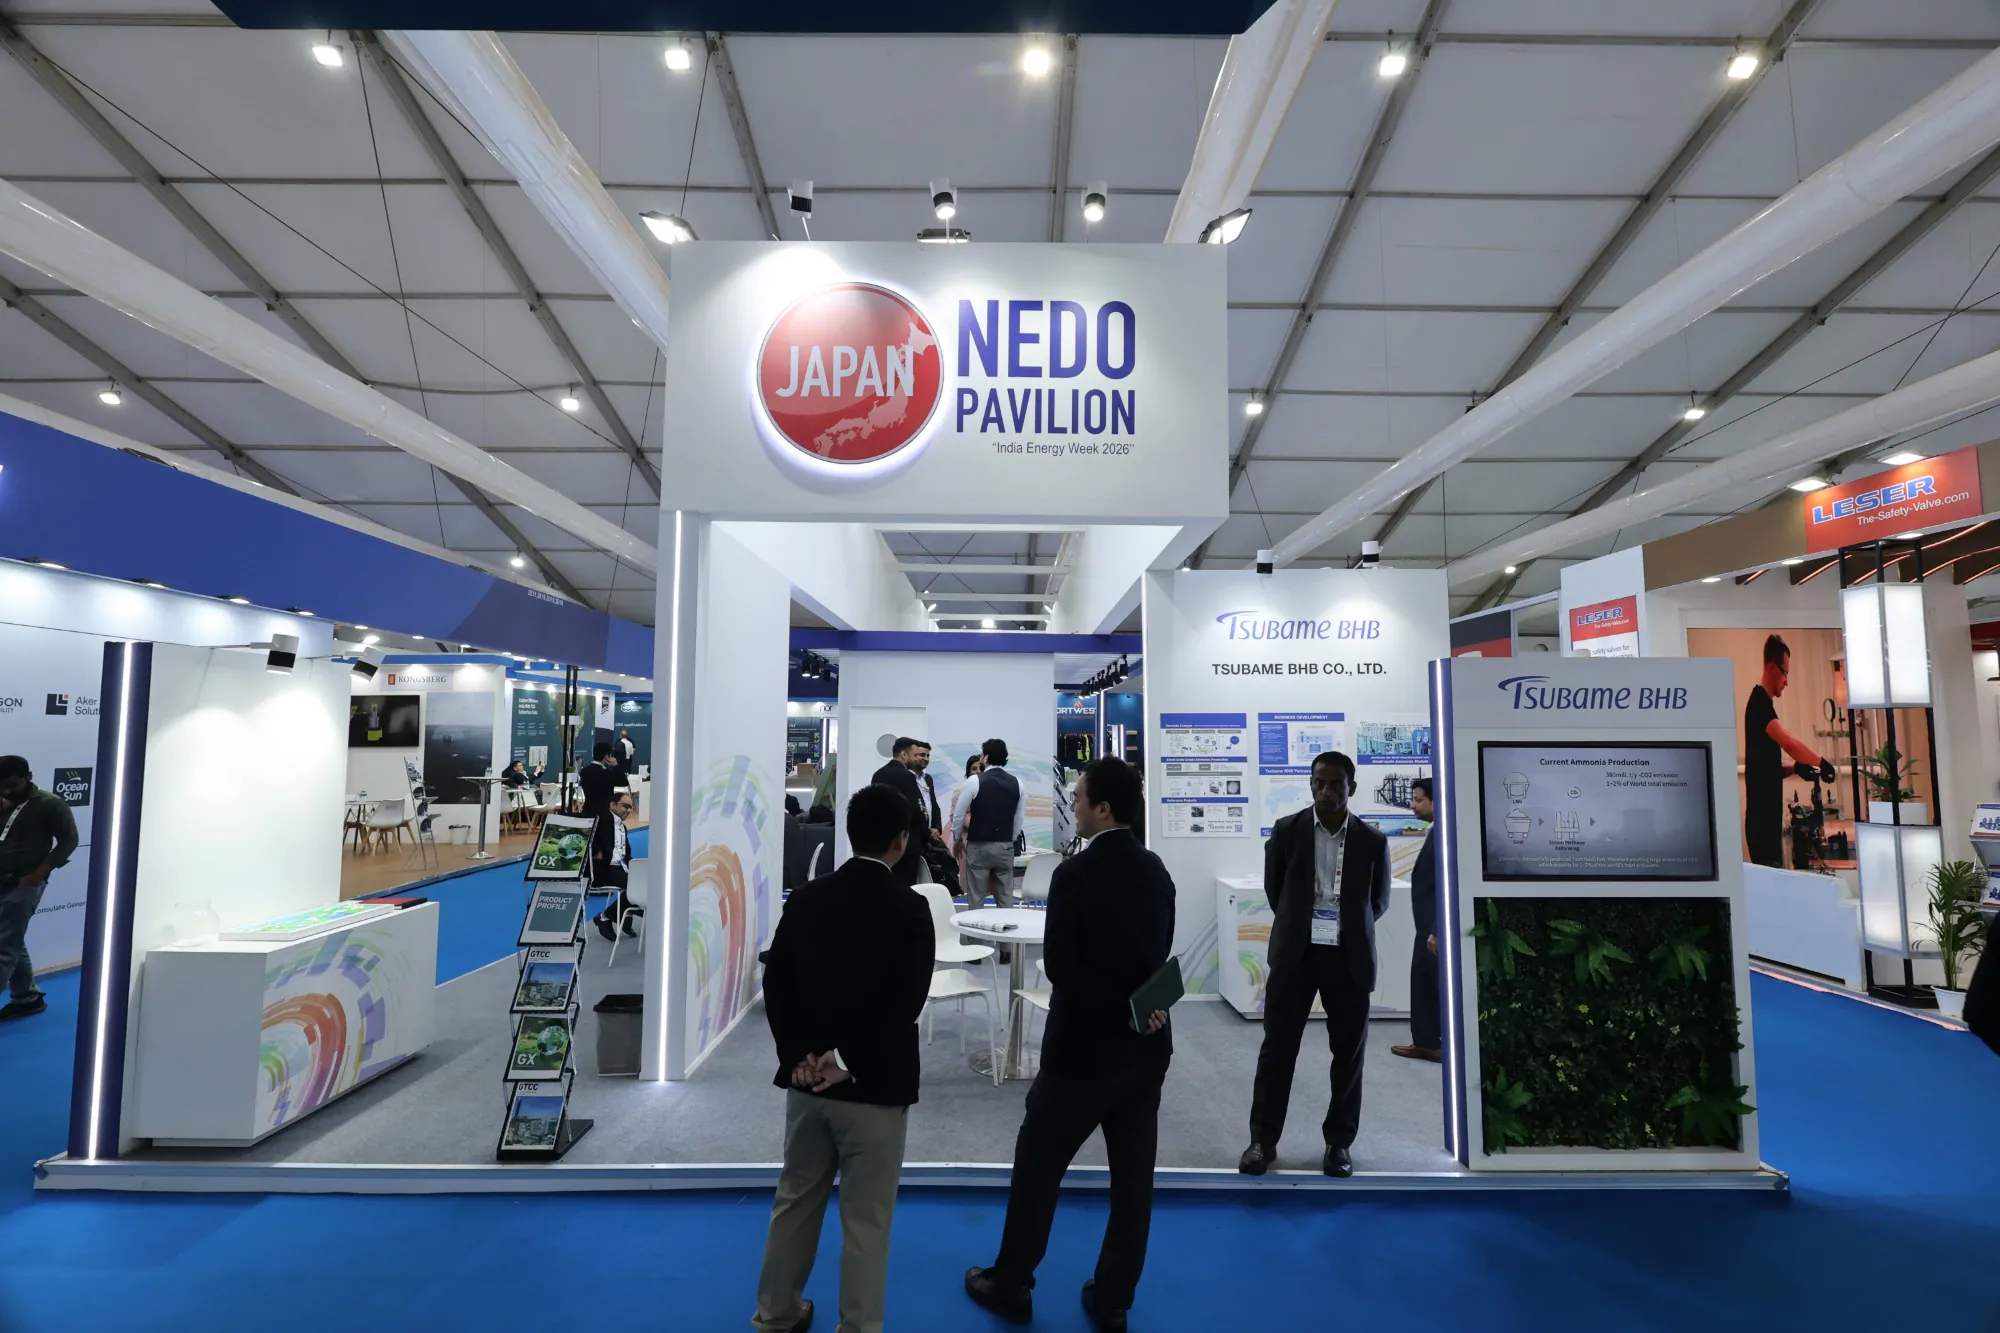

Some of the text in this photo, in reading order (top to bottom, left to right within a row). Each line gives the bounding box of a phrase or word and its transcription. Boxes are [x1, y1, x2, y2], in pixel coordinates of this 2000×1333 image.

[958, 300, 1136, 380] NEDO
[775, 345, 914, 398] JAPAN
[956, 388, 1136, 435] PAVILION
[1025, 443, 1065, 457] Energy
[1066, 443, 1099, 455] Week
[1812, 475, 1937, 525] LESER
[1856, 490, 1970, 526] The-Safety-Valve.com
[1577, 607, 1623, 626] LESER
[1337, 618, 1380, 640] BHB
[1212, 663, 1387, 678] TSUBAME BHB CO., LTD.
[398, 675, 447, 683] KONGSBERG
[75, 696, 98, 706] Aker
[1638, 687, 1688, 710] BHB
[1540, 758, 1650, 767] Current Ammonia Production
[56, 782, 89, 792] Ocean
[63, 792, 83, 802] Sun
[538, 855, 557, 867] GX
[539, 895, 574, 904] PRODUCT
[35, 904, 66, 914] onsulate
[536, 902, 568, 910] PROFILE
[530, 950, 551, 958] GTCC
[517, 1053, 537, 1066] GX
[518, 1083, 539, 1091] GTCC
